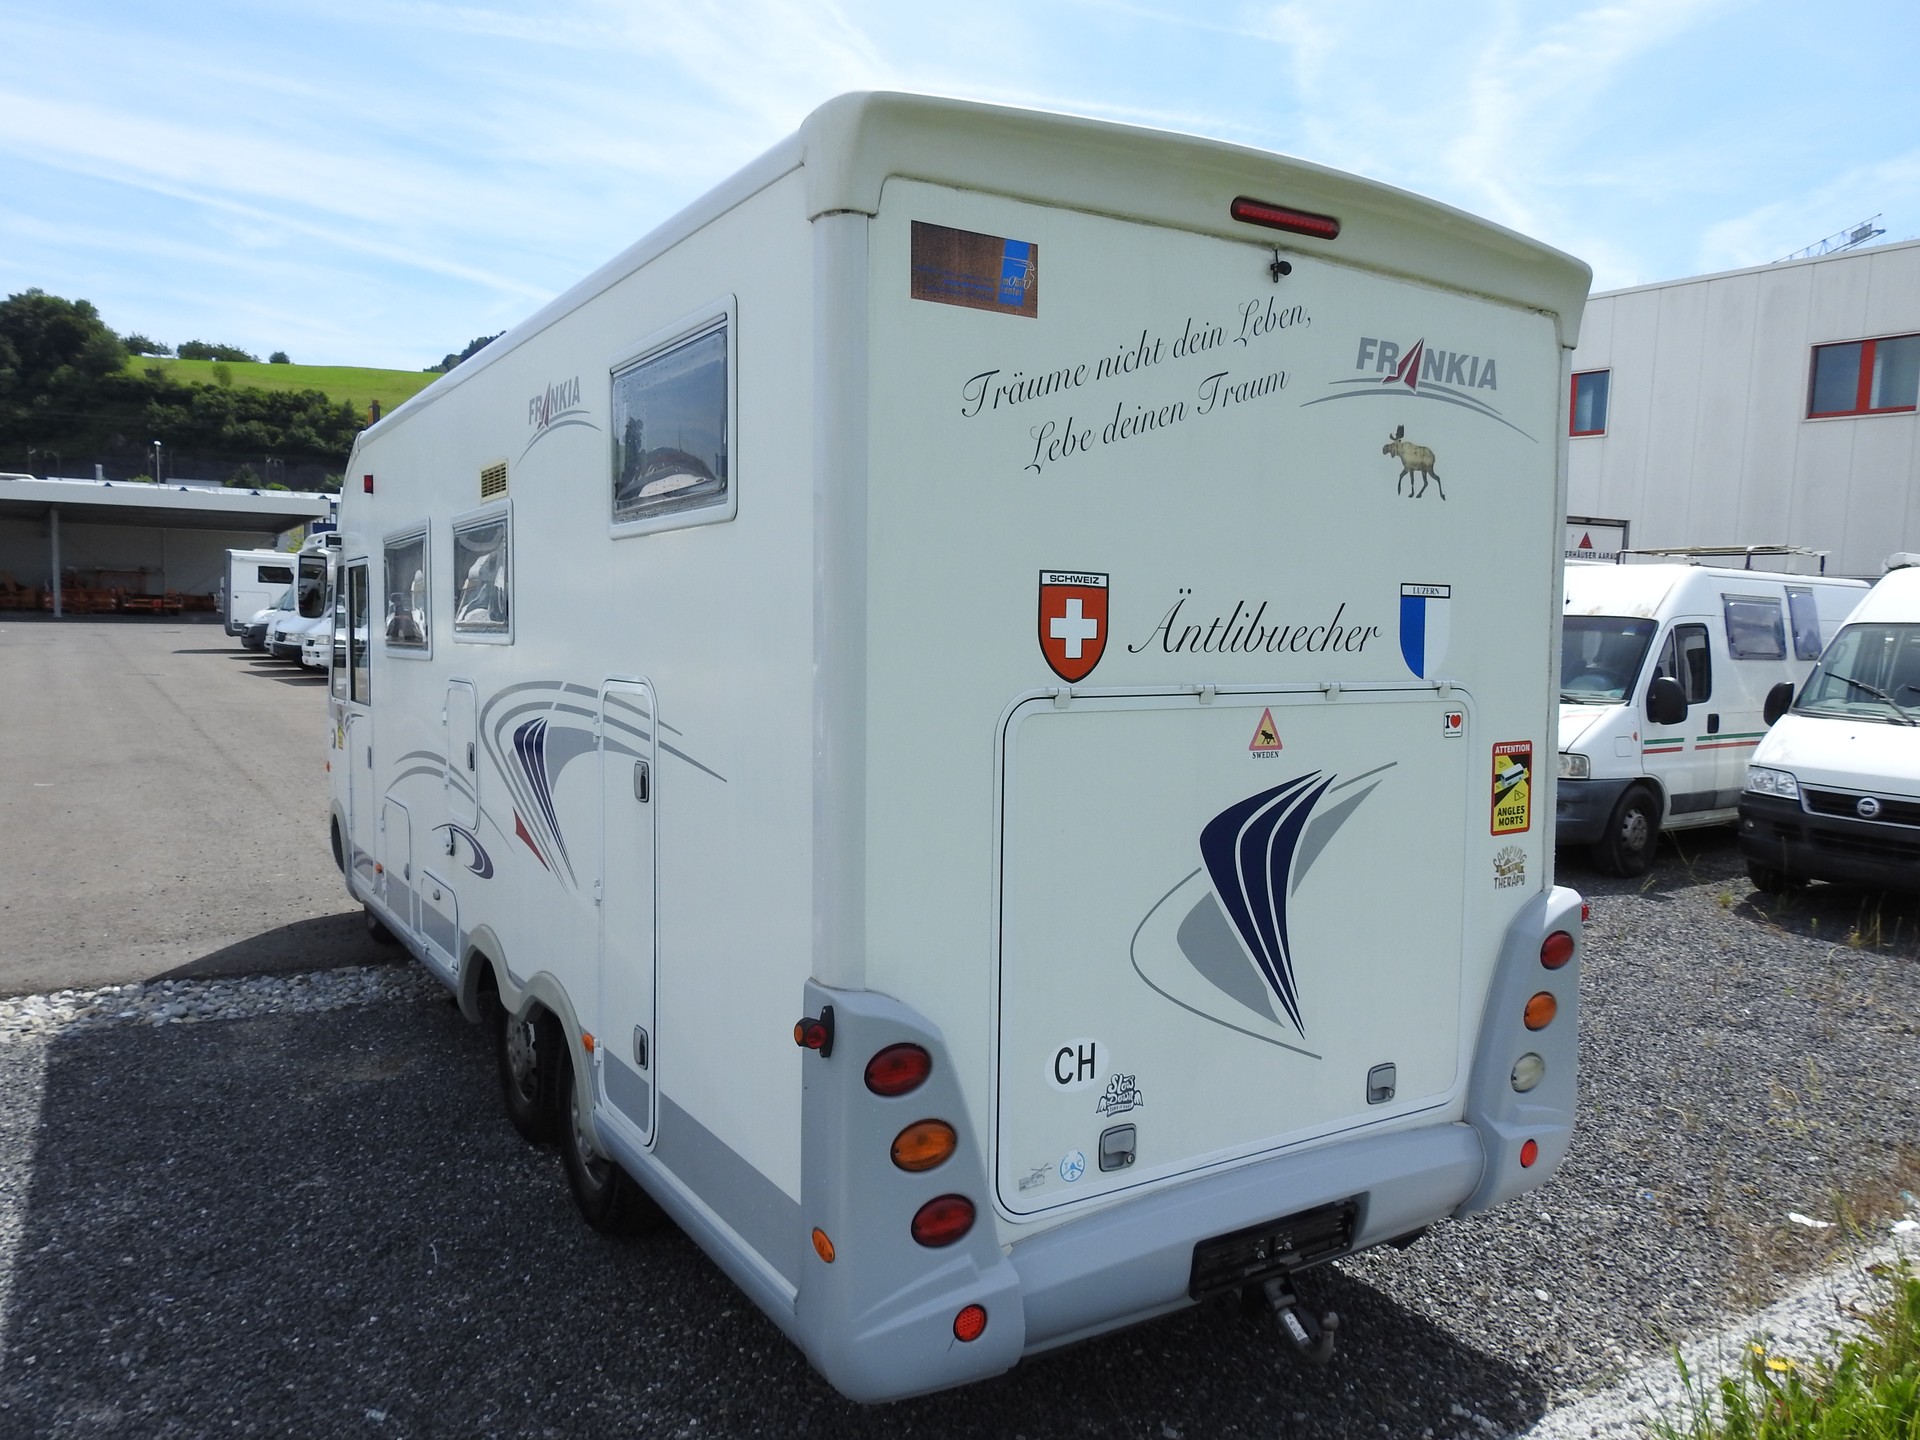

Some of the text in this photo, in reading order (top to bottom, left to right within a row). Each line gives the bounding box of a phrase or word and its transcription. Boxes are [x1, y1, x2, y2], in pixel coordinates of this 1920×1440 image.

[961, 296, 1311, 417] Träume nicht dein Leben,
[1356, 337, 1497, 394] FRANKIA
[528, 376, 580, 429] FRANKIA
[1024, 371, 1290, 474] Lebe deinen Traum
[1049, 574, 1099, 584] SCHWEIZ
[1412, 586, 1440, 595] LUZERN
[1127, 588, 1382, 654] Äntlibuecher
[1251, 751, 1280, 759] SWEDEN
[1495, 743, 1530, 754] ATTENTION
[1497, 805, 1525, 817] ANGLES
[1498, 815, 1524, 827] MORTS
[1493, 845, 1527, 868] CAMPING
[1493, 875, 1525, 889] THERAPY
[1055, 1042, 1096, 1085] CH
[1107, 1074, 1135, 1094] Slow
